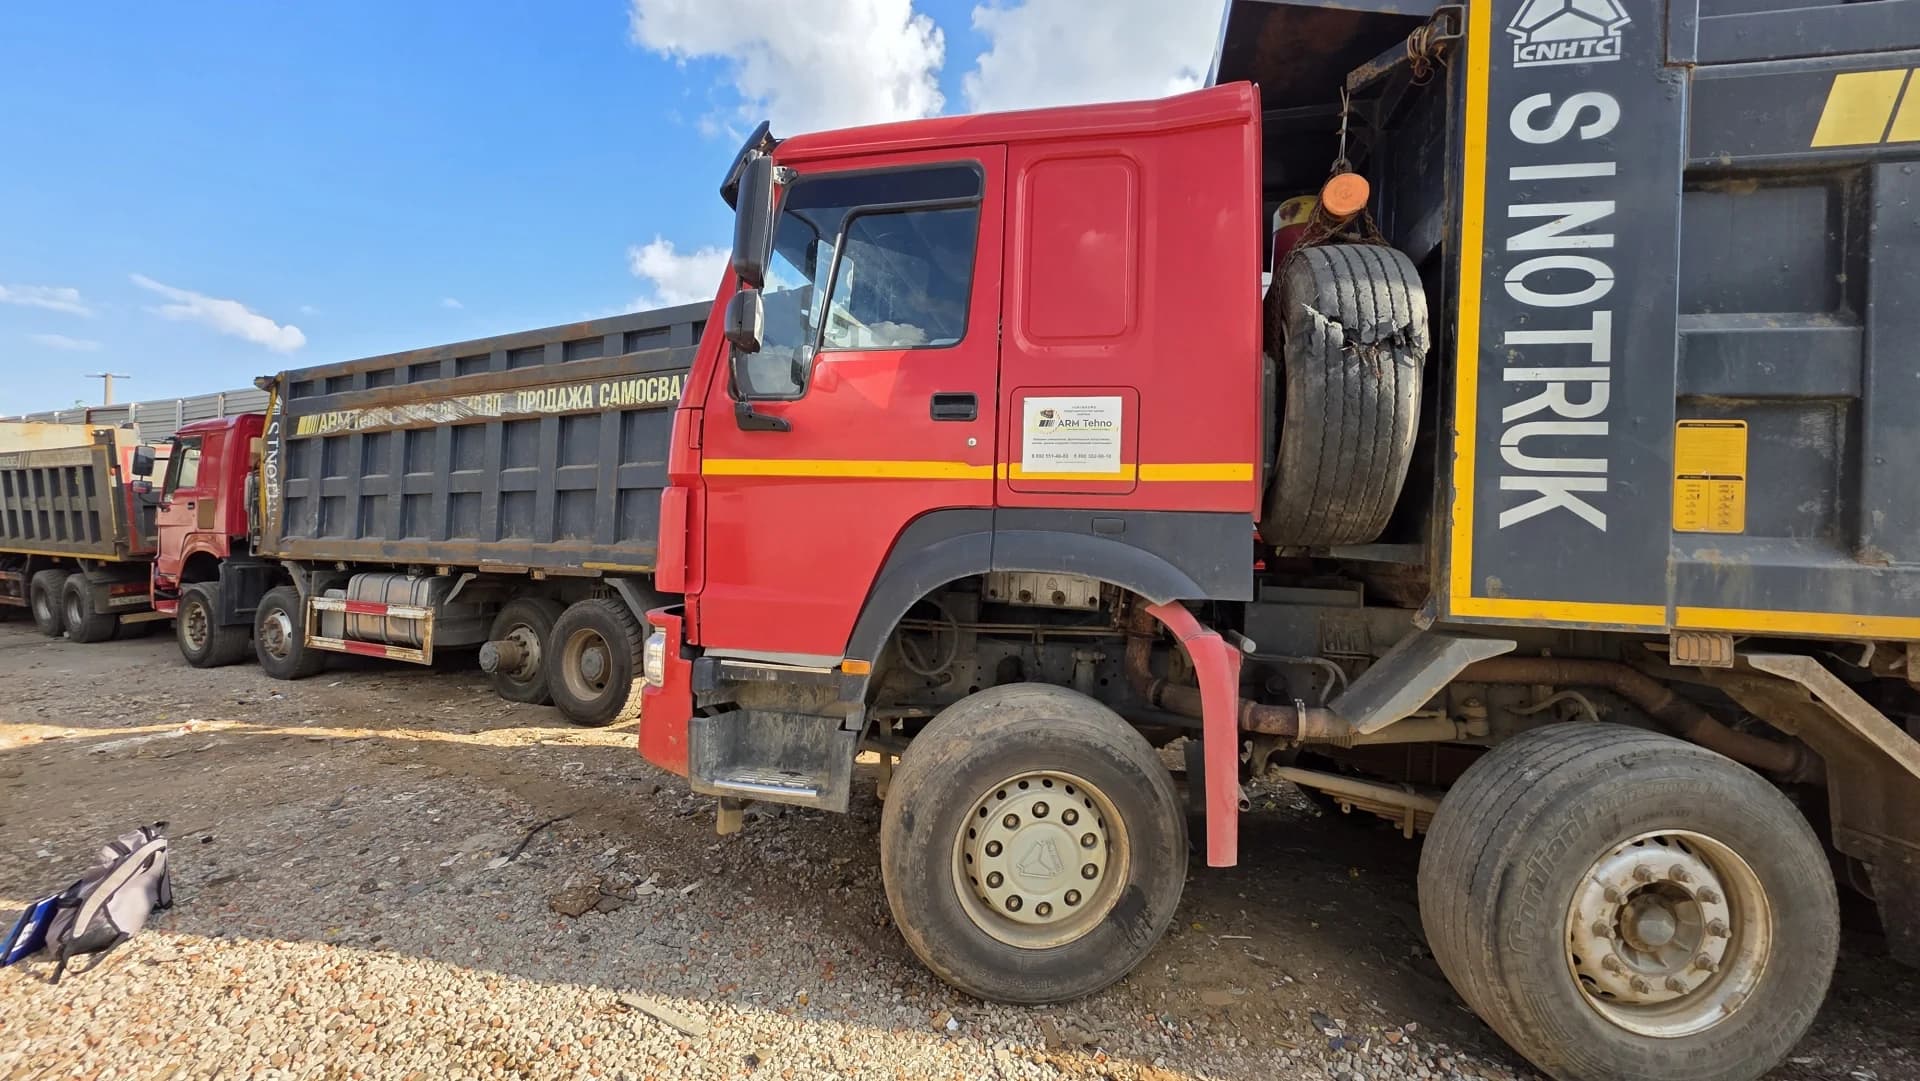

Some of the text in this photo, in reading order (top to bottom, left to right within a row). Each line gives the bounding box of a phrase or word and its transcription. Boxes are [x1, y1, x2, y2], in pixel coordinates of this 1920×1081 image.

[1519, 37, 1614, 60] CNHTC
[1499, 91, 1621, 532] SINOTRUK
[517, 384, 594, 410] ПРОДАЖА
[1058, 418, 1113, 428] ARM Tehno
